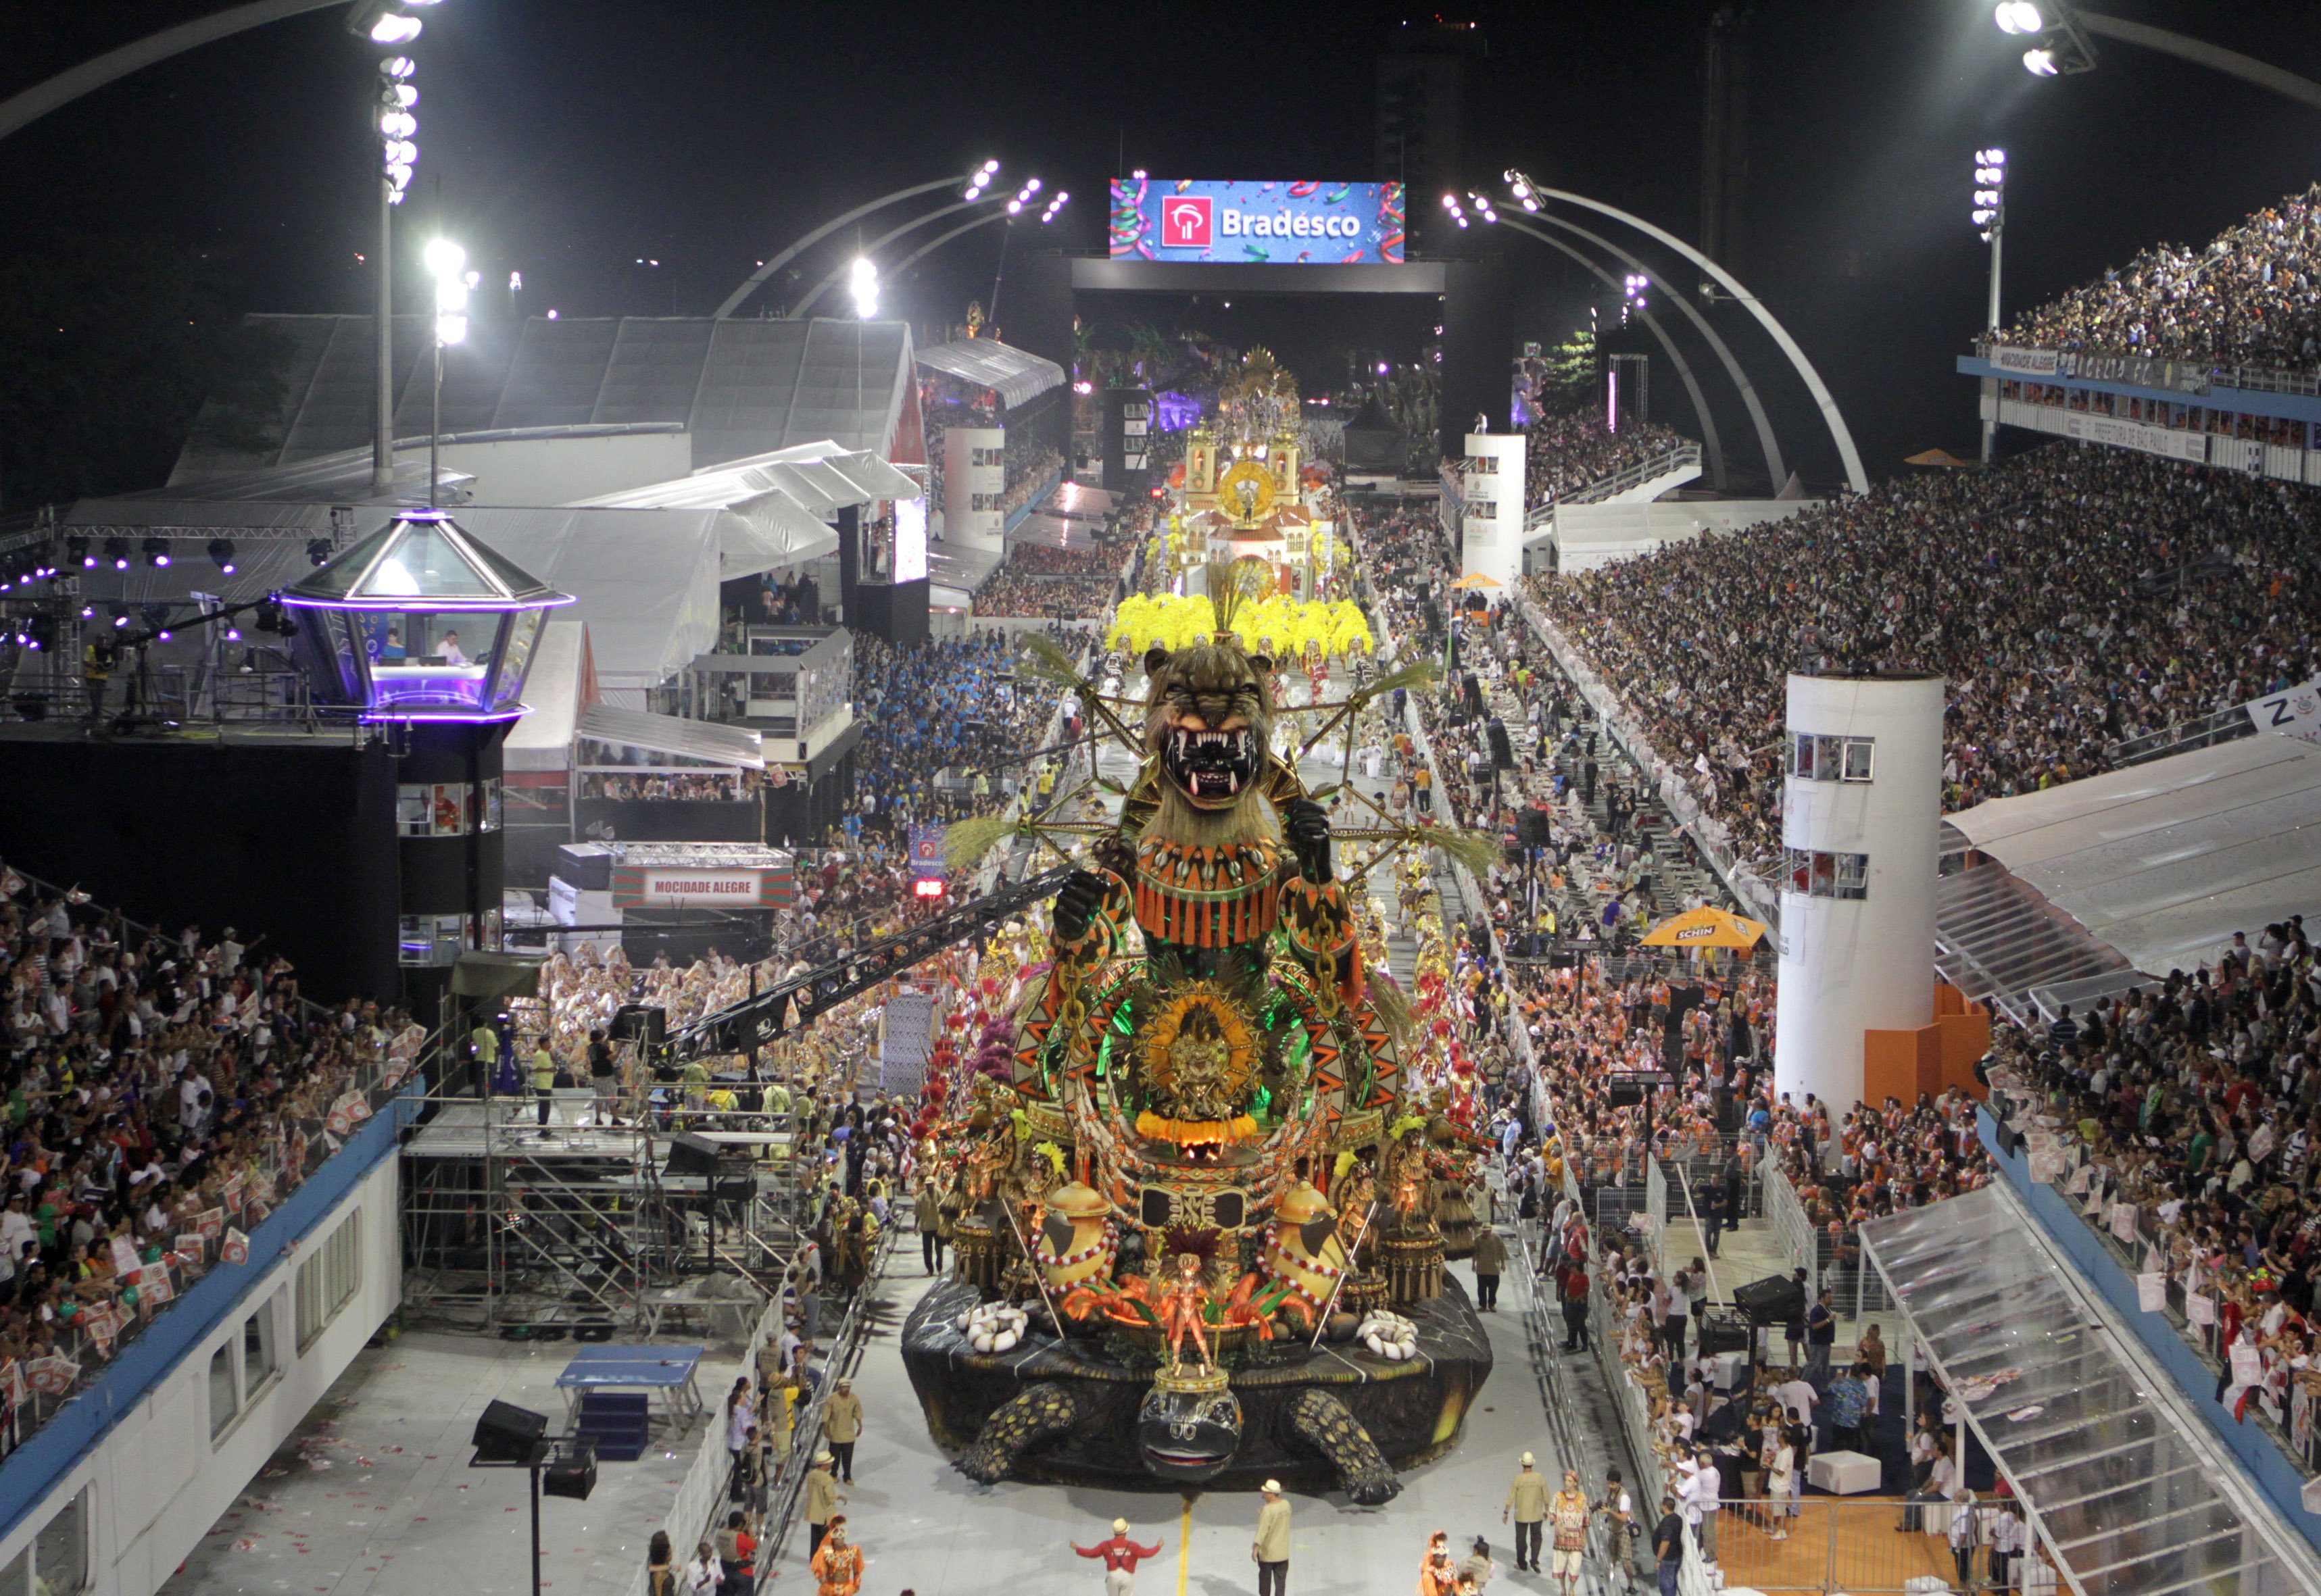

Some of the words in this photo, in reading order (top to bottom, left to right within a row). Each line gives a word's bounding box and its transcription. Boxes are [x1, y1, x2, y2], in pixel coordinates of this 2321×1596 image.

[1222, 208, 1361, 237] Bradesco
[654, 881, 711, 893] MOCIDADE
[712, 882, 751, 893] ALEGRE
[1678, 926, 1713, 939] SCHIN
